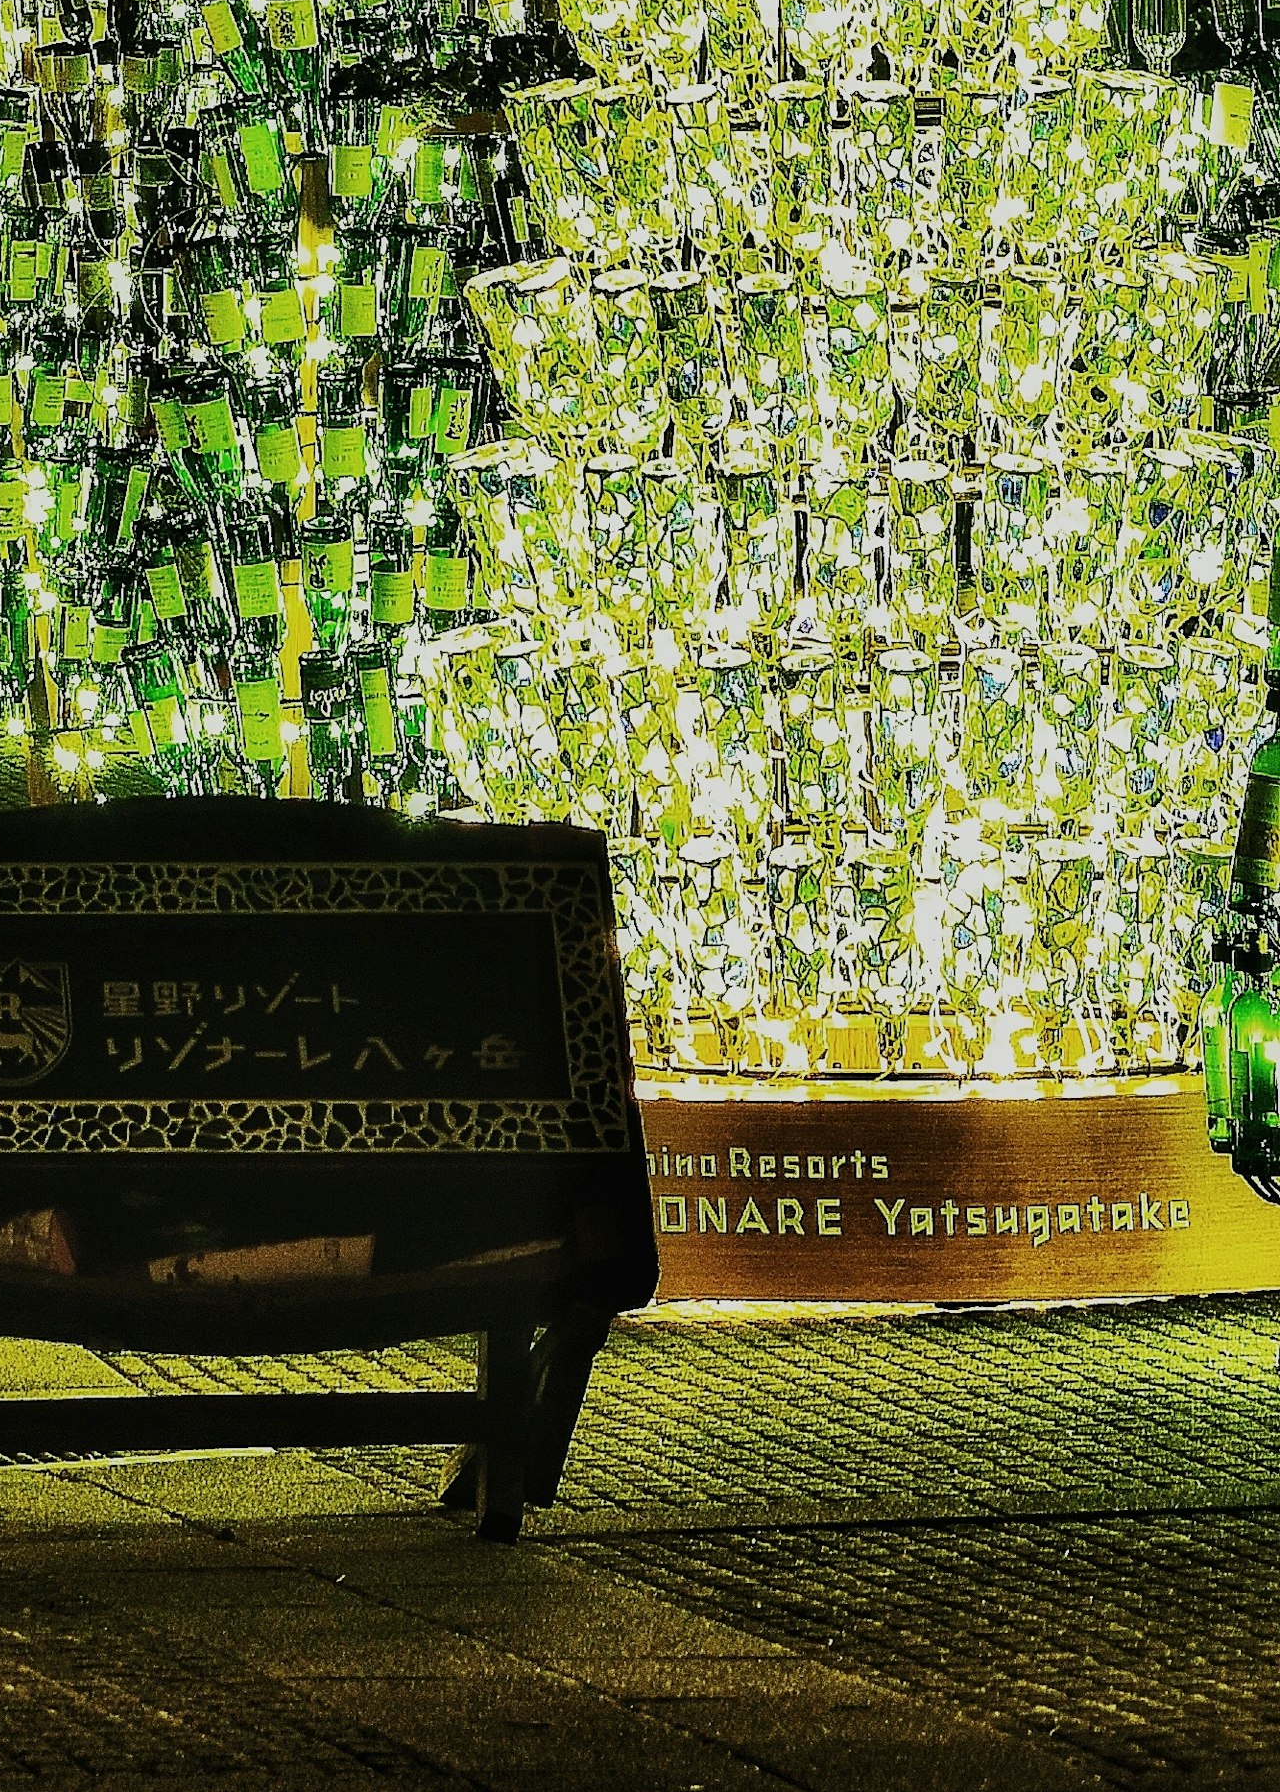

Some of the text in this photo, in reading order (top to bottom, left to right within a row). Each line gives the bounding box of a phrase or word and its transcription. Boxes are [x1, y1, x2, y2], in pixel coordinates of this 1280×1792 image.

[102, 971, 360, 1019] 星野リゾート
[728, 1146, 890, 1180] Resorts
[658, 1191, 1192, 1248] ONARE Yatsugatake
